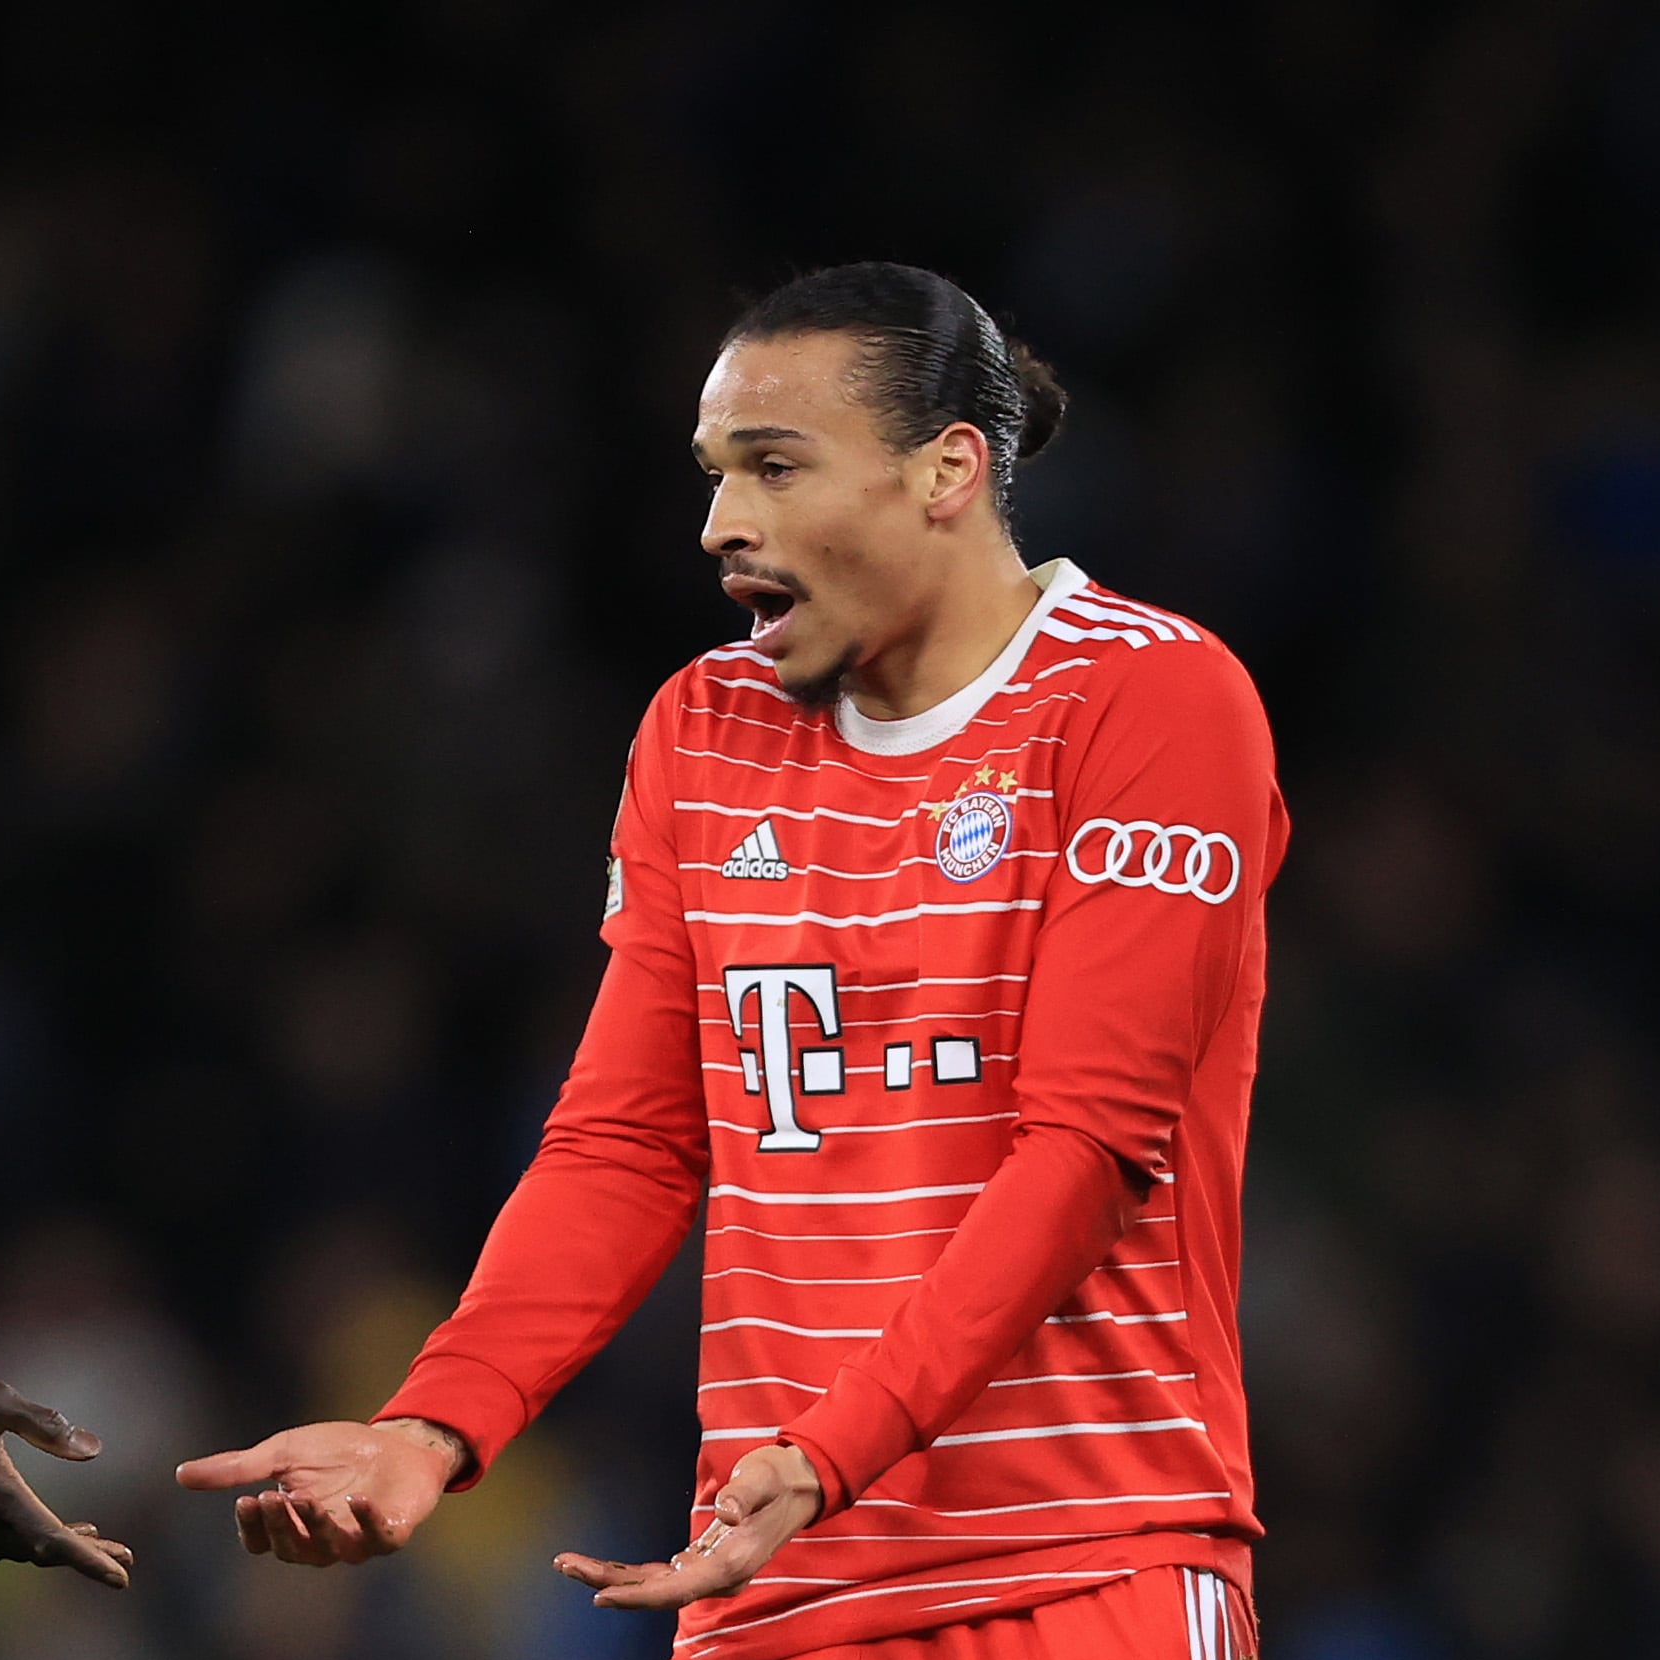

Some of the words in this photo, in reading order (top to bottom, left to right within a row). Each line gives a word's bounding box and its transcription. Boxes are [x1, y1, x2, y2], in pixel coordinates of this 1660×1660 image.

[943, 811, 959, 833] FC
[960, 796, 1006, 829] BAYERN
[721, 856, 790, 880] adidas
